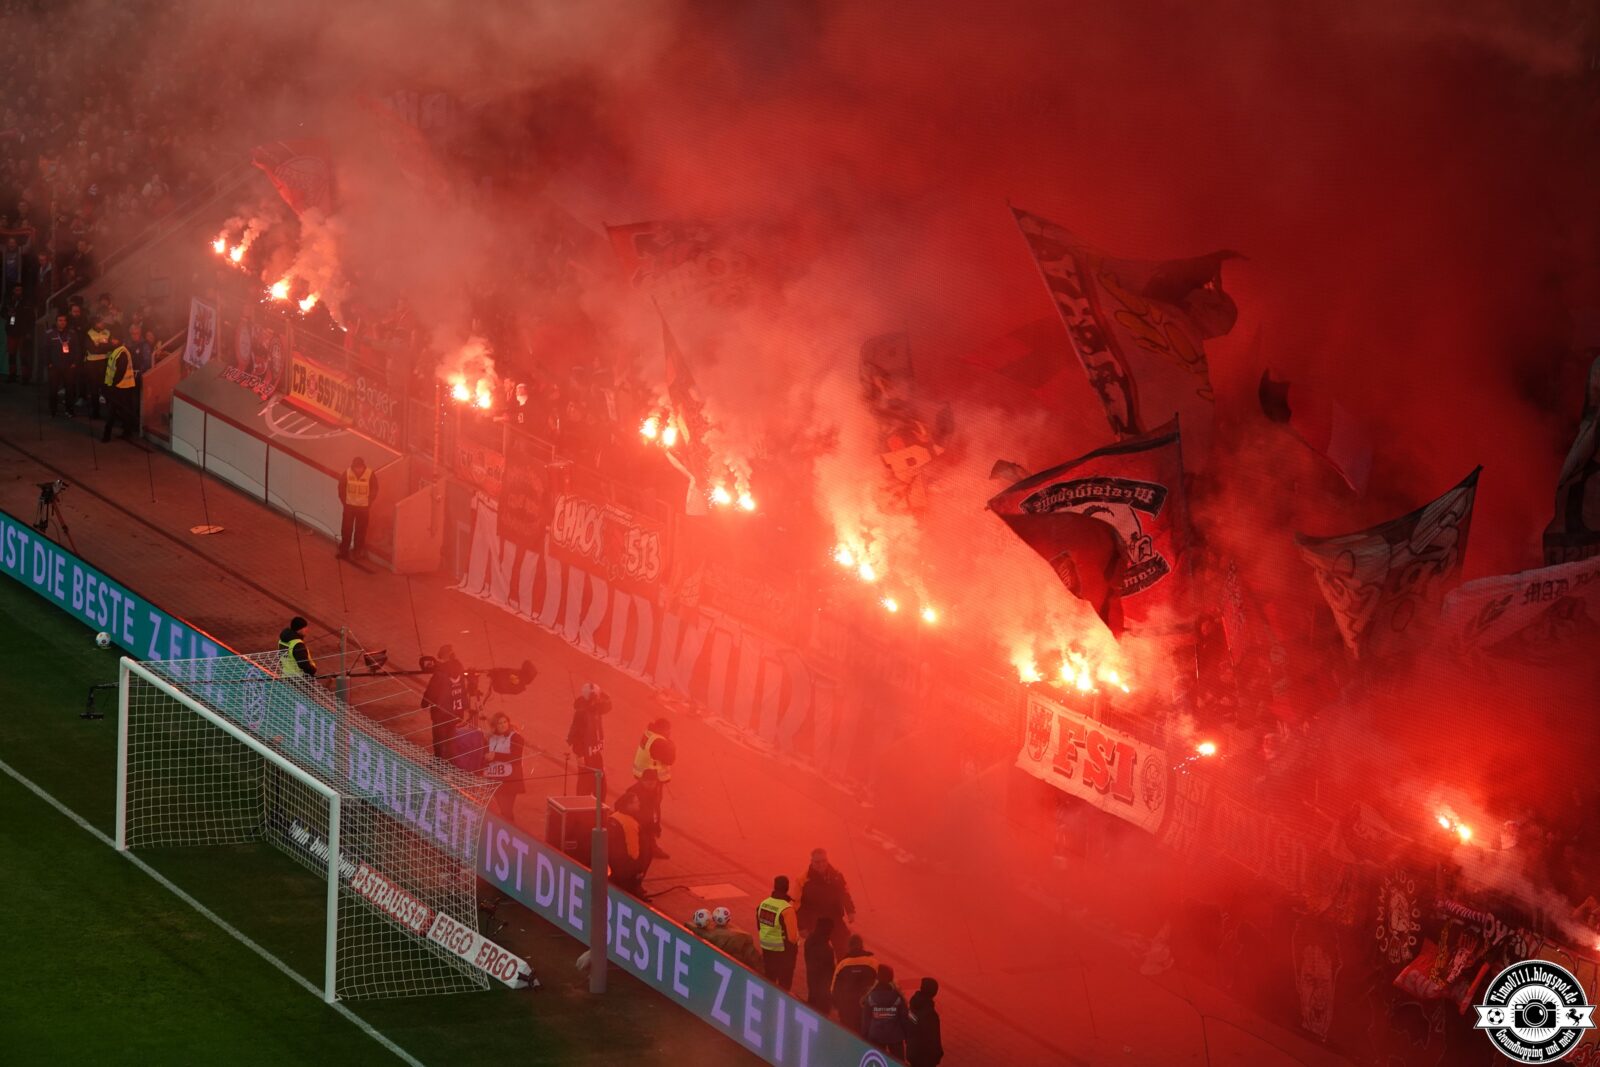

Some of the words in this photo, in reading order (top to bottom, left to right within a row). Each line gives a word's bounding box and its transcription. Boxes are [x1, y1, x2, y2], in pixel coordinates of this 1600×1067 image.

[0, 519, 28, 575] IST
[33, 540, 66, 600] DIE
[72, 564, 136, 646] BESTE
[626, 522, 661, 582] 513
[1053, 713, 1137, 807] FSI
[363, 872, 417, 924] STRAUSS
[431, 914, 475, 956] ERGO
[475, 942, 519, 982] ERGO
[485, 821, 529, 893] IST
[535, 853, 585, 931] DIE
[607, 895, 691, 999] ESTE
[710, 959, 819, 1067] ZEIT
